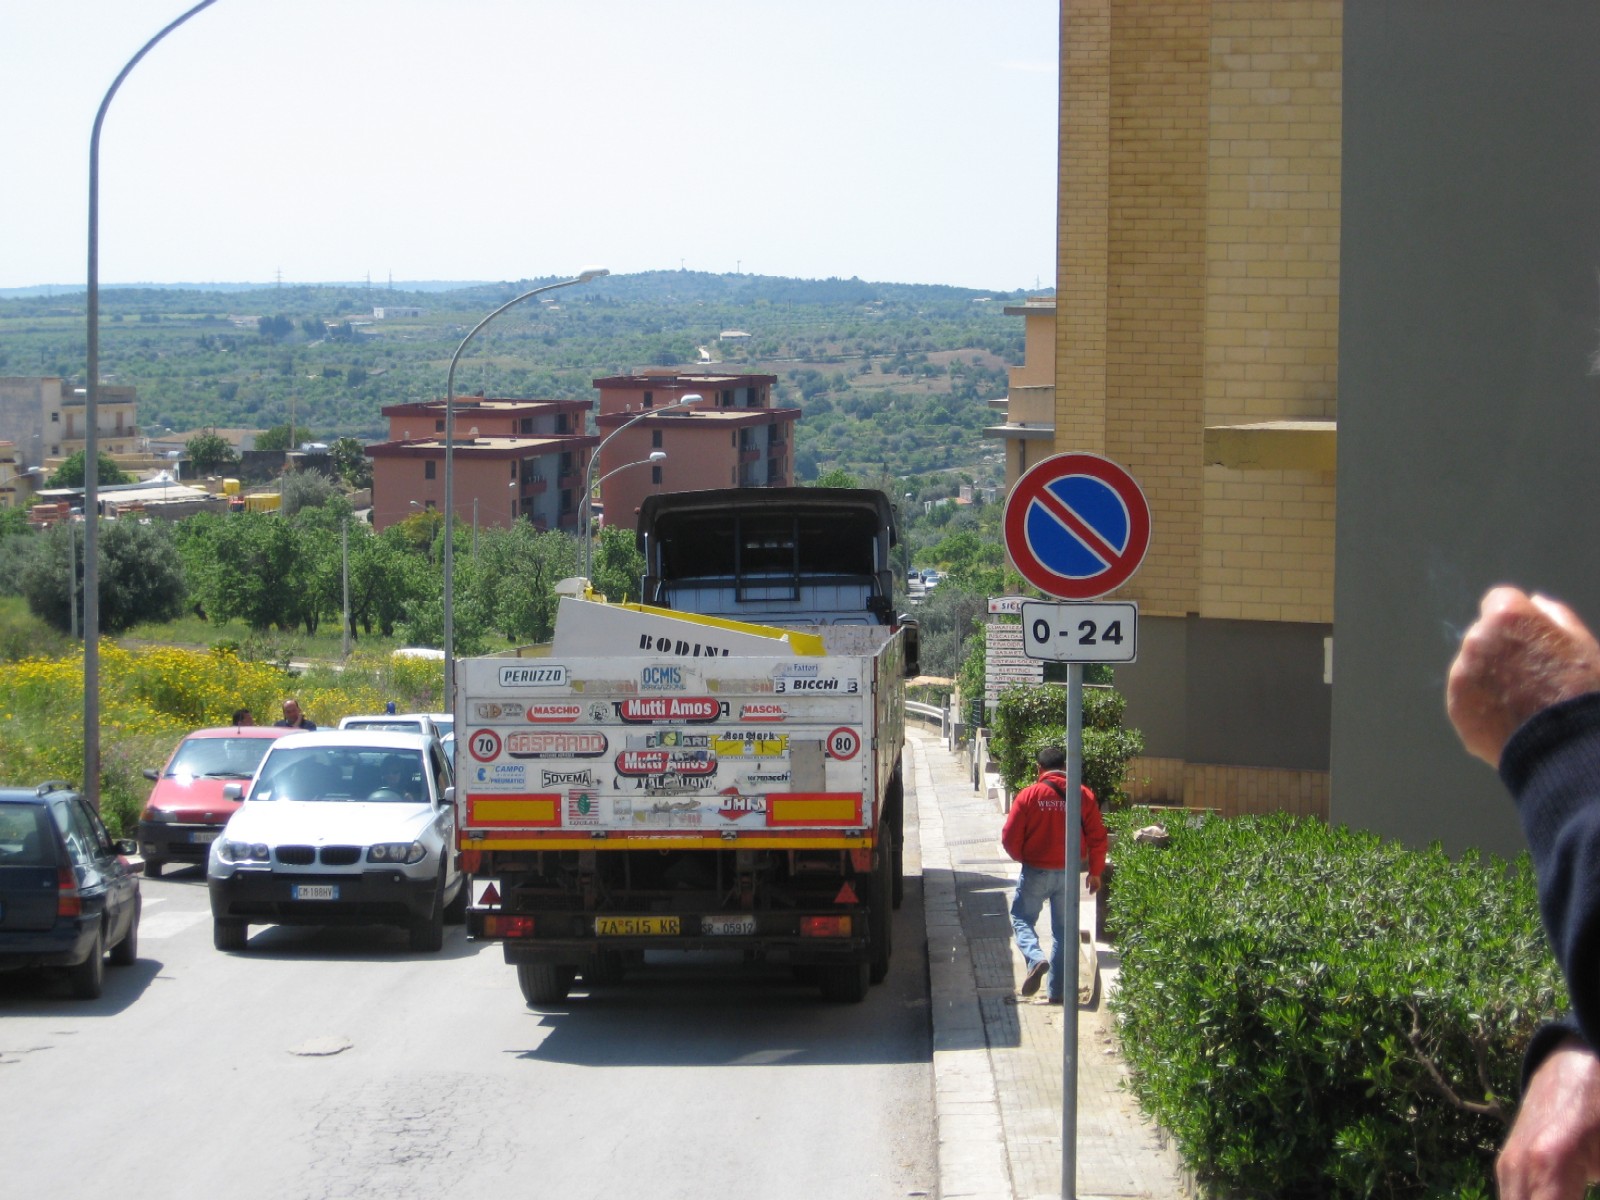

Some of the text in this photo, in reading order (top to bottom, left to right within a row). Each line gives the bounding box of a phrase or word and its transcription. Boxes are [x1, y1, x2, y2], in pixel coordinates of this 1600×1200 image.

[503, 669, 562, 682] PERUZZO
[642, 666, 682, 684] OCMIS
[533, 706, 580, 714] MASCHIO
[628, 700, 665, 716] Mutti
[669, 700, 712, 715] Amos
[744, 705, 782, 713] MASCH
[478, 739, 494, 752] 70
[835, 737, 851, 751] 80
[624, 752, 662, 770] Mutti
[494, 765, 525, 773] CAMPO
[543, 771, 590, 787] SOVEMA
